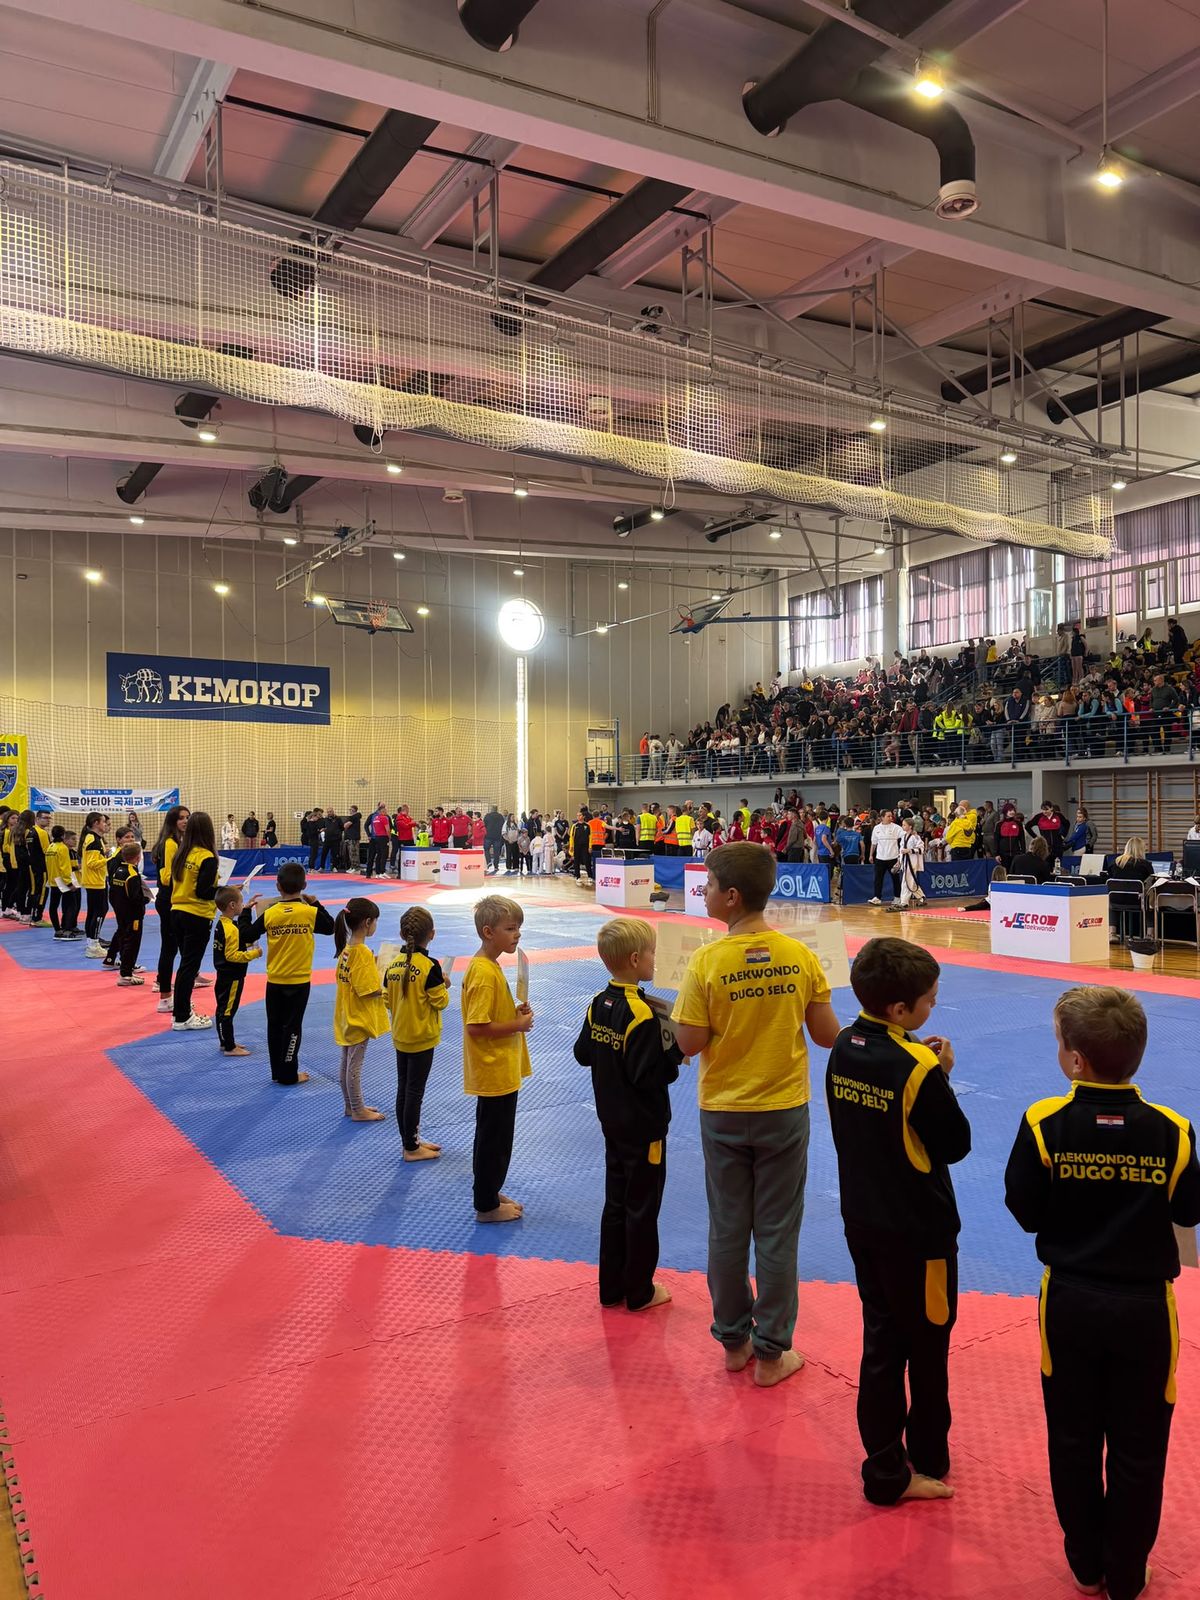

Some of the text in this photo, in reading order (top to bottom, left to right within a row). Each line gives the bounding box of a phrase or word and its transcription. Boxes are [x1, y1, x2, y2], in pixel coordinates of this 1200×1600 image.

[169, 675, 321, 707] KEMOKOP
[60, 796, 111, 806] 크로아티아
[114, 796, 153, 806] 국제교류
[931, 873, 969, 889] JOOLA
[1024, 924, 1056, 932] taekwondo
[720, 964, 800, 986] TAEKWONDO
[729, 983, 796, 1002] DUGO SELO
[284, 1033, 298, 1062] Joma
[831, 1073, 871, 1093] EKWONDO
[833, 1085, 860, 1104] UGO
[1054, 1152, 1166, 1168] TAEKWONDO KLU
[1060, 1164, 1167, 1185] DUGO SELO
